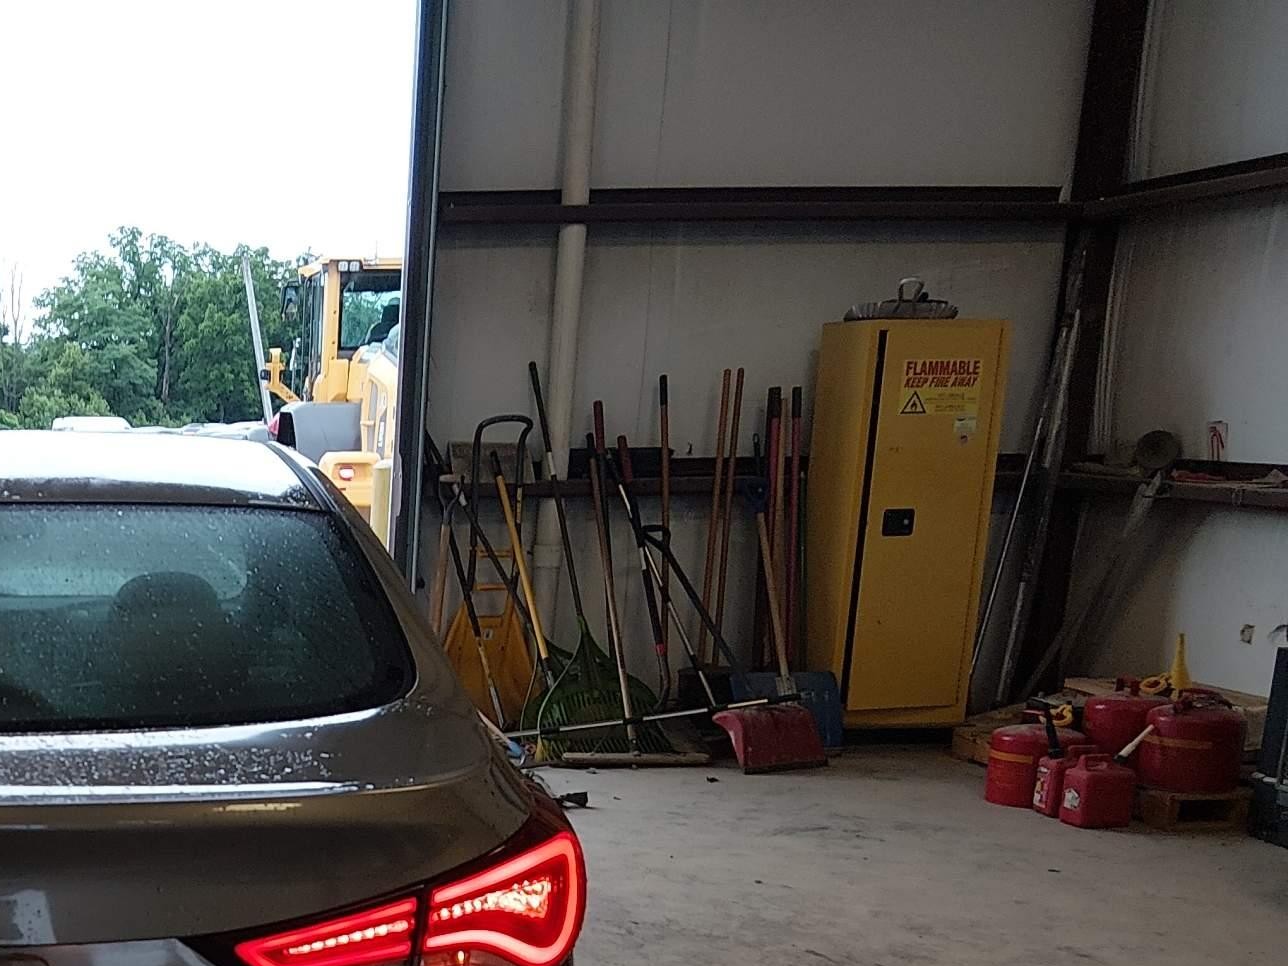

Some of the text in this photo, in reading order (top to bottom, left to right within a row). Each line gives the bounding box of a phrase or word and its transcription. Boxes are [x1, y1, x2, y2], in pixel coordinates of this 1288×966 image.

[906, 360, 981, 376] FLAMMABLE
[904, 376, 979, 388] KEEP FIRE AWAY
